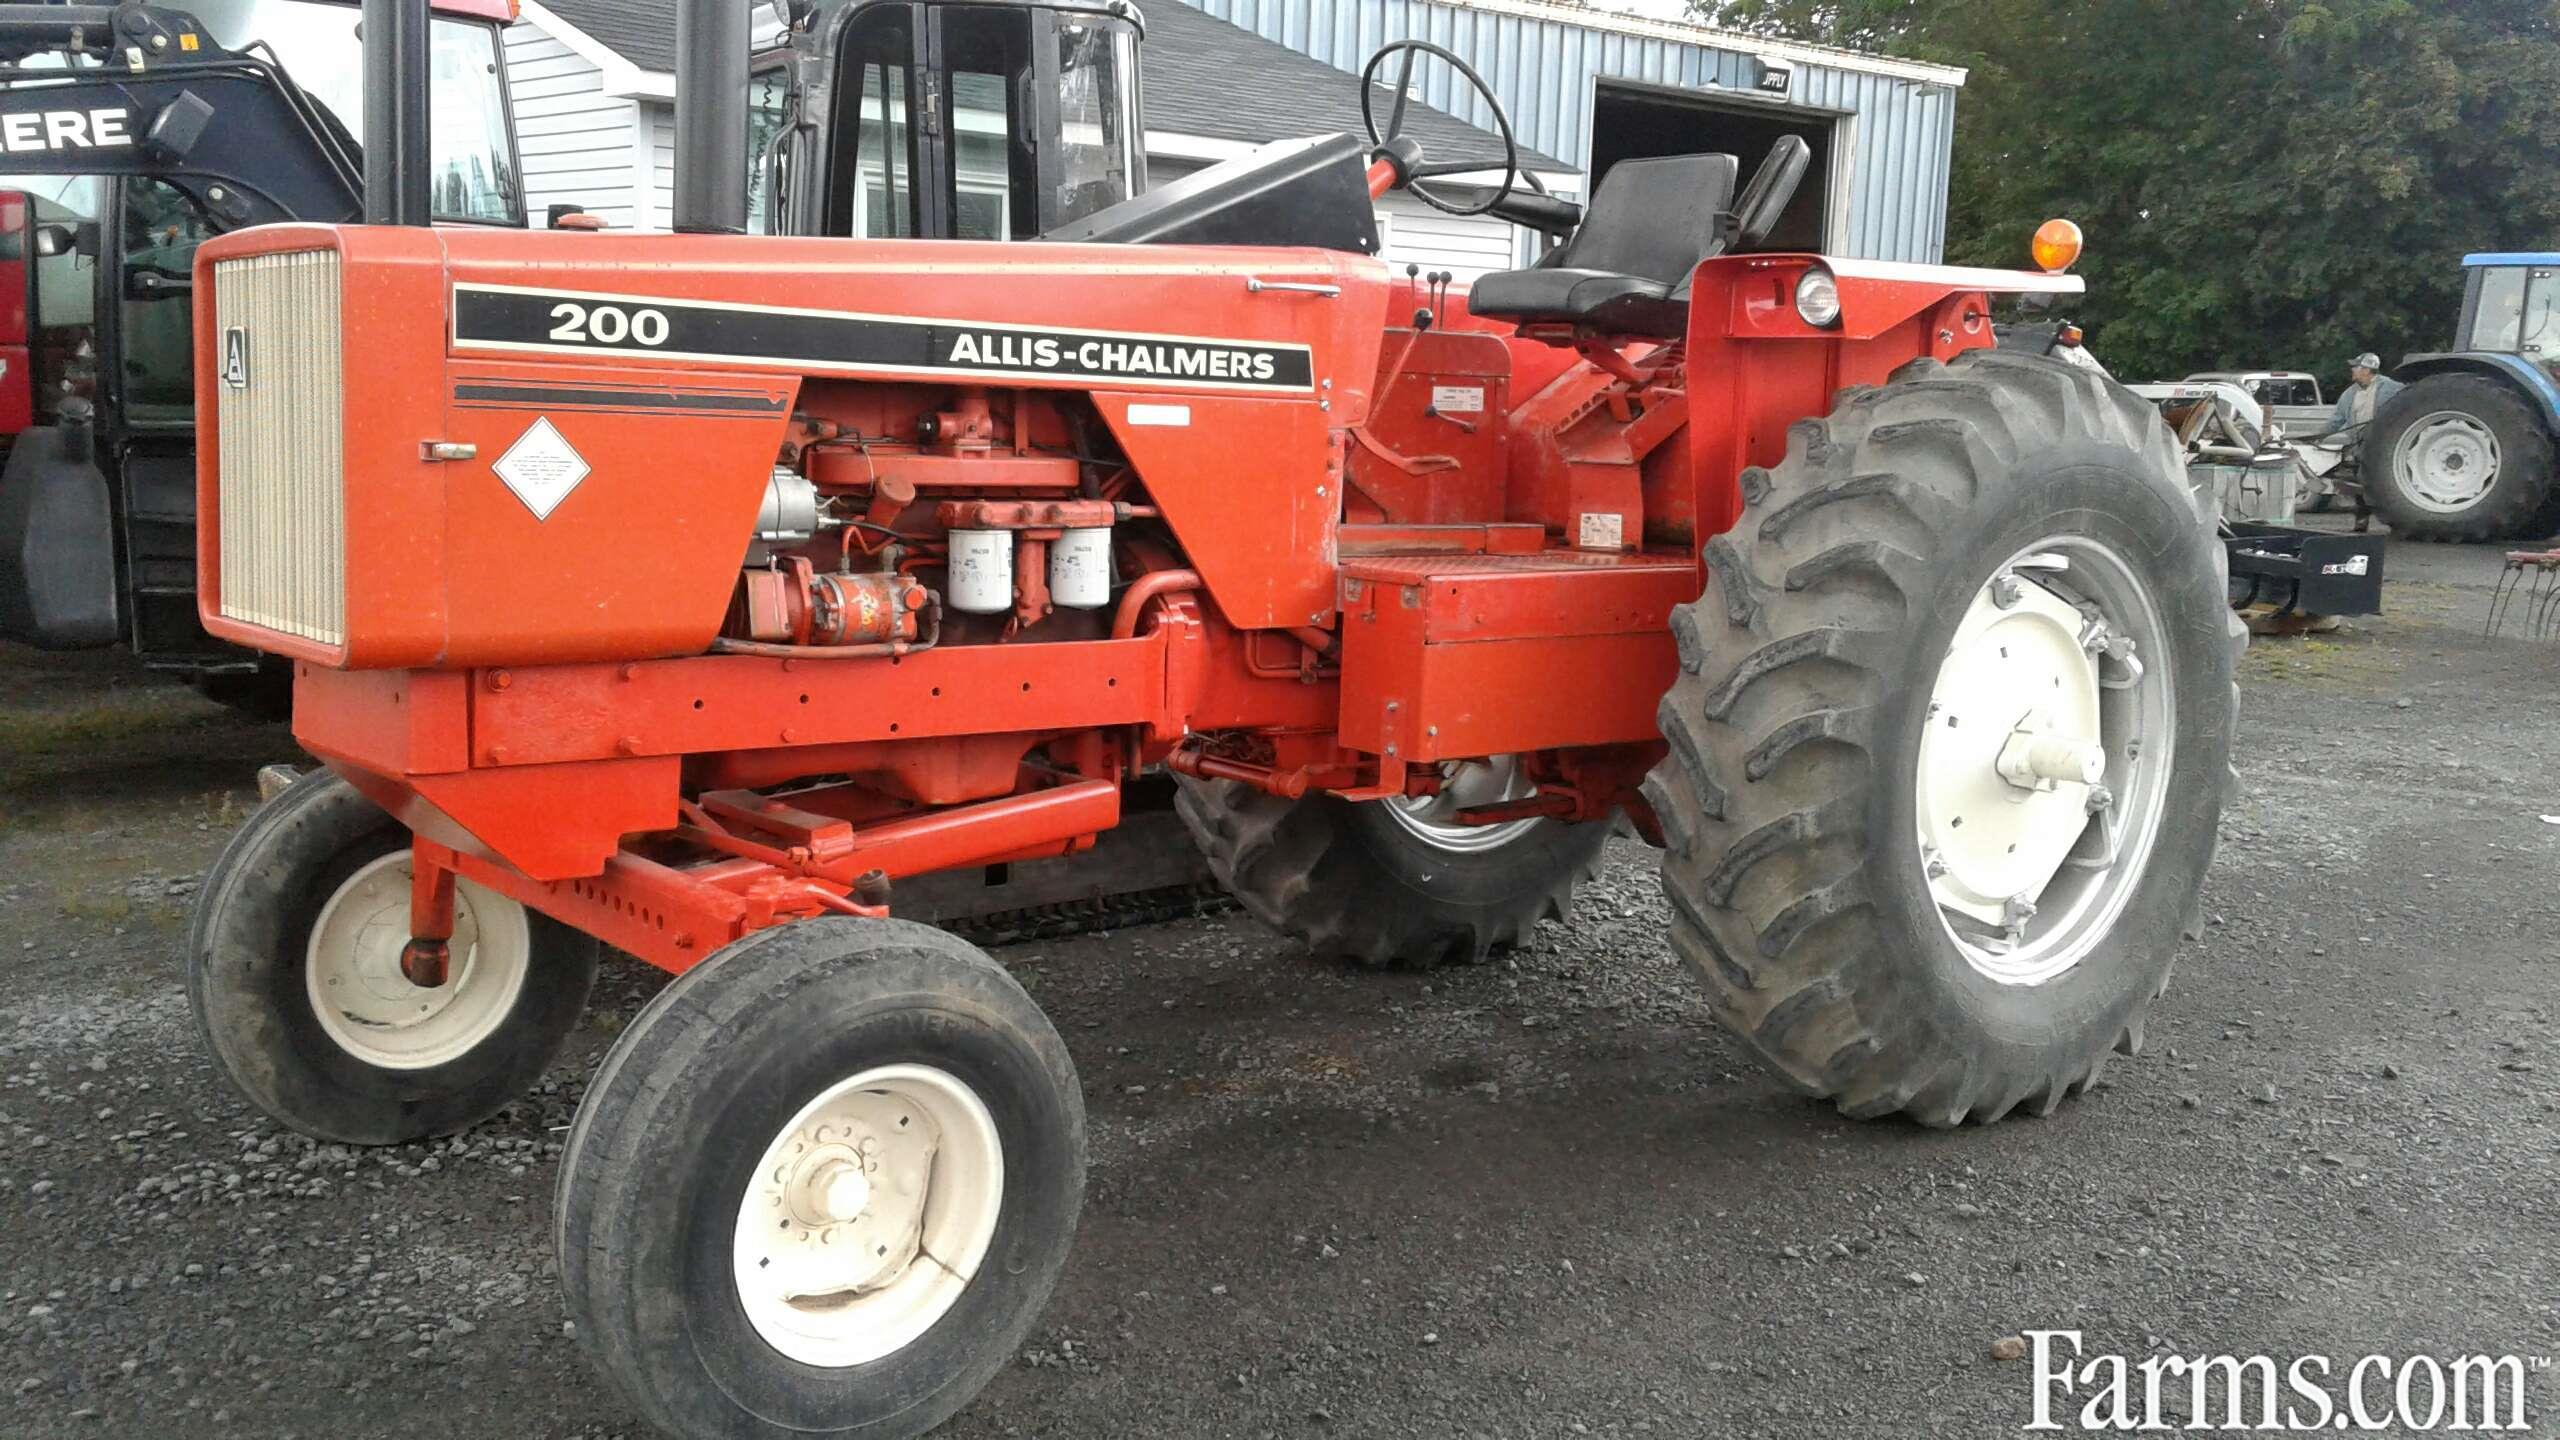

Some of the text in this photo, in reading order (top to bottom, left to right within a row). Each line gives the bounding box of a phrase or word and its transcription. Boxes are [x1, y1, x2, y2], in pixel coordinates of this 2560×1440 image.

[0, 108, 132, 153] ERE
[549, 303, 670, 346] 200
[949, 334, 1275, 379] ALLIS-CHALMERS
